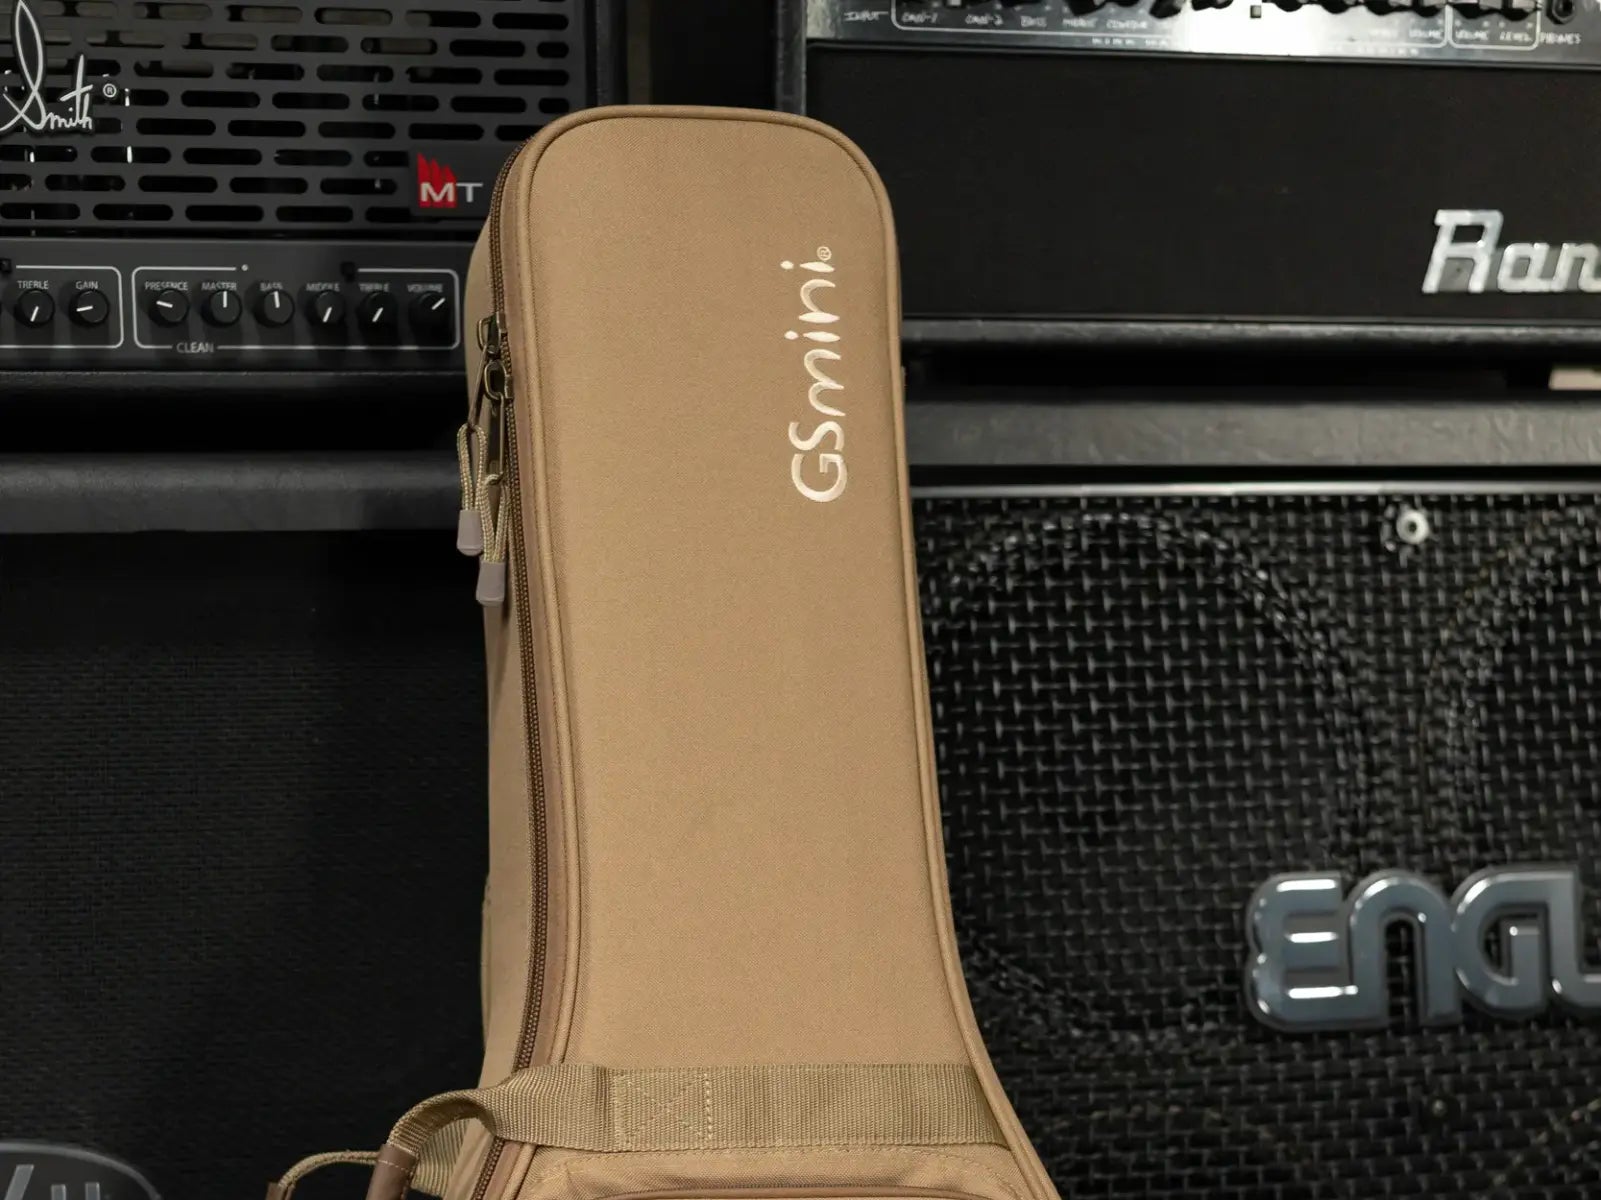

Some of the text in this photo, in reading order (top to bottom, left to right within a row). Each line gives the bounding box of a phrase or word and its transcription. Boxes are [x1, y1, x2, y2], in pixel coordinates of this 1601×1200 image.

[420, 182, 483, 203] MT
[17, 280, 49, 290] TREBLE
[75, 280, 98, 290] GAIN
[145, 281, 188, 291] PRESENCE
[201, 282, 237, 291] MASTER
[176, 342, 214, 354] CLEAN
